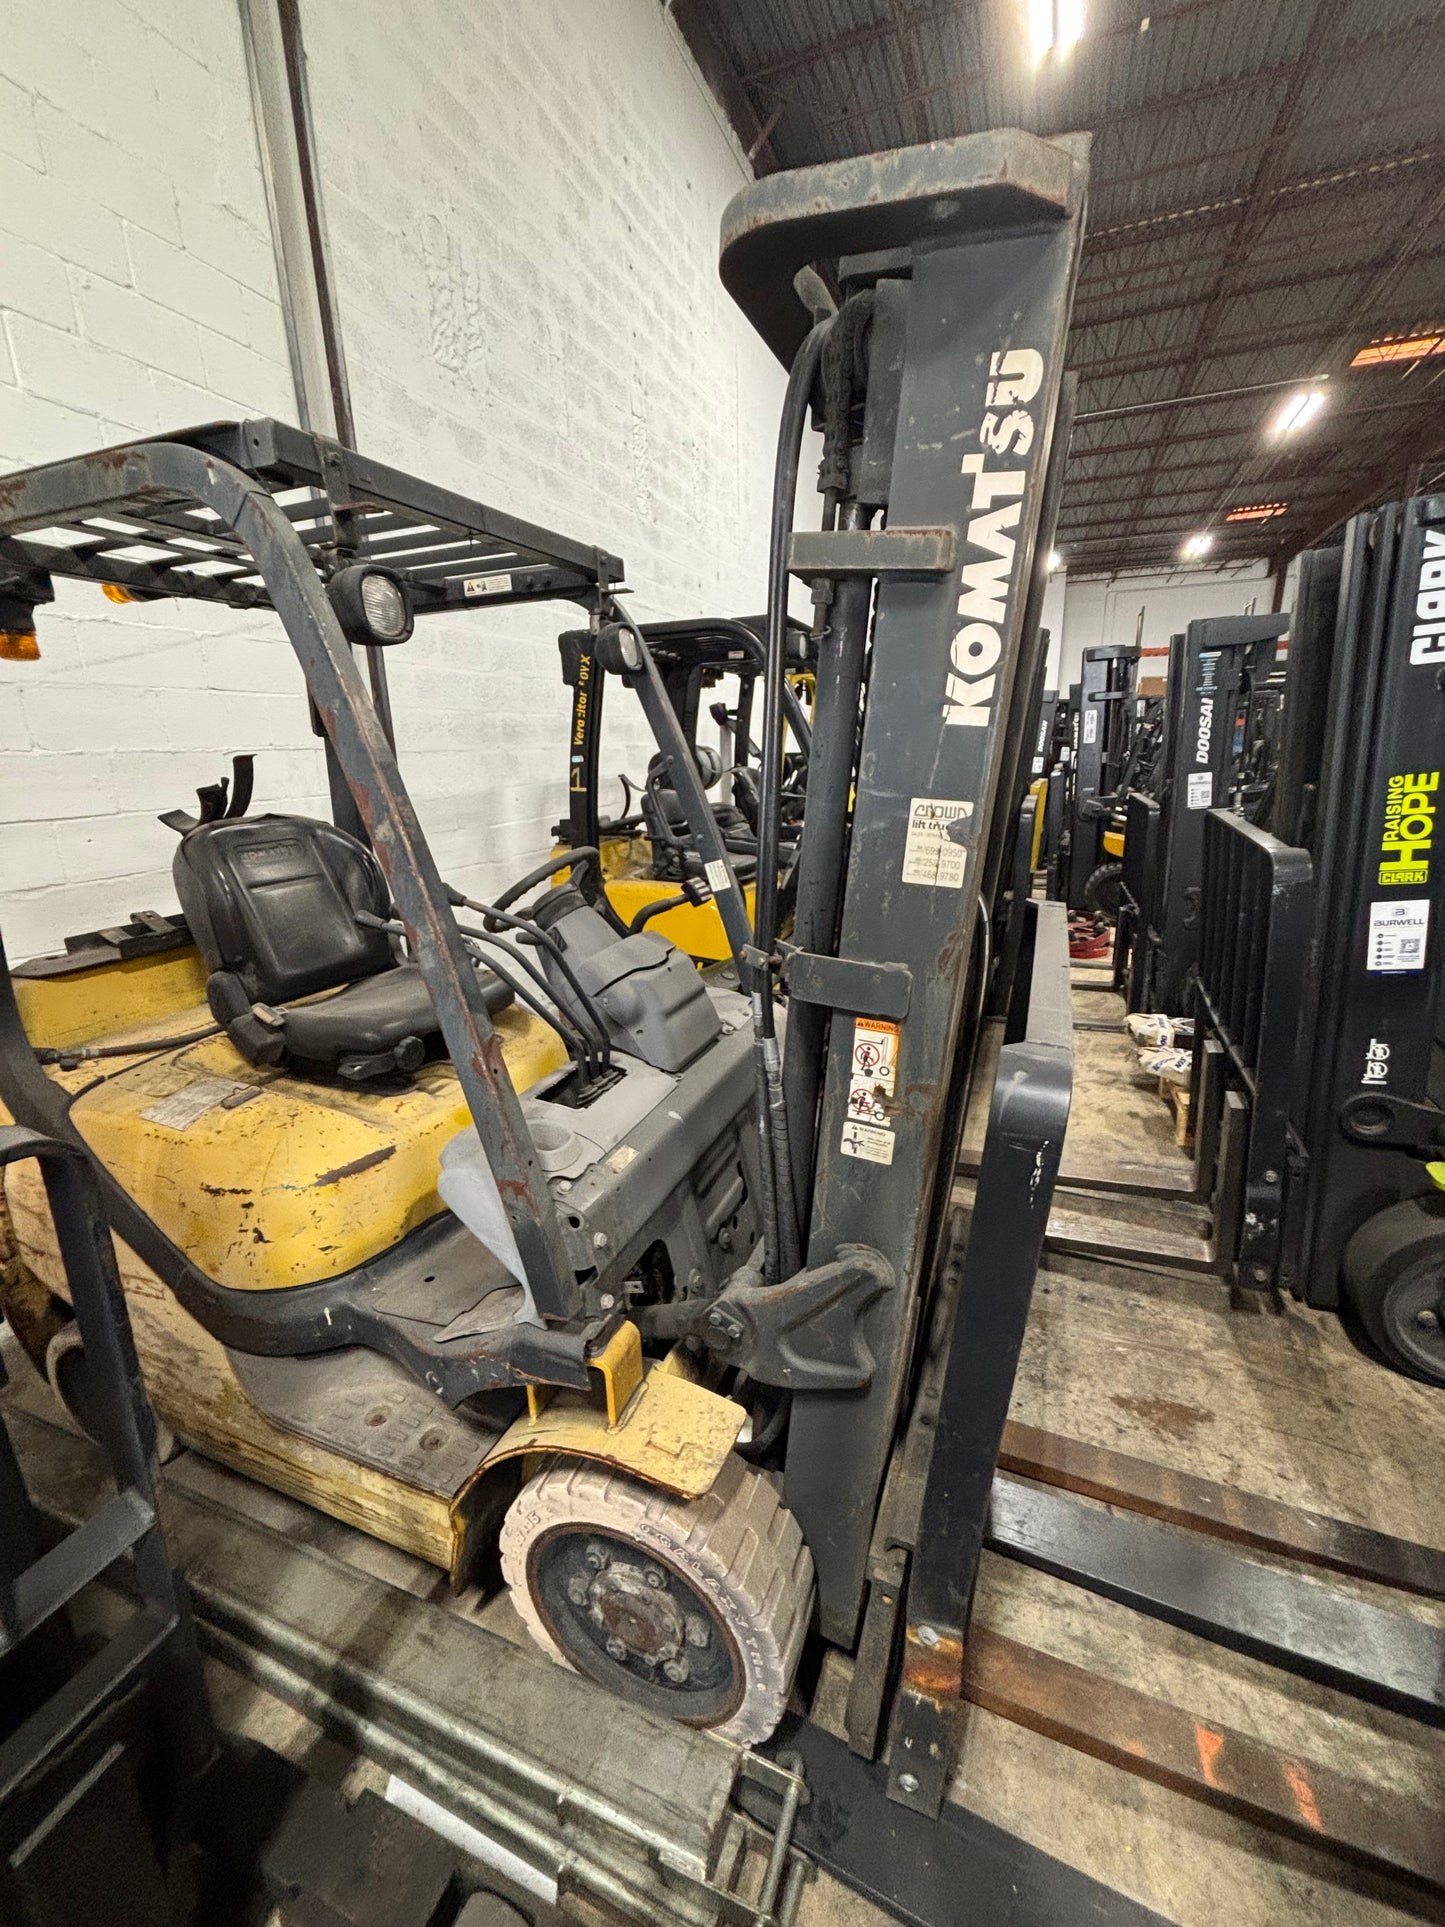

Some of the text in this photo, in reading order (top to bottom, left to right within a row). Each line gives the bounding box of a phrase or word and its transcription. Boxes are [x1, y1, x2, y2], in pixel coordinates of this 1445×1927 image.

[941, 347, 1044, 727] KOMATSU
[911, 819, 927, 830] lift
[1379, 771, 1440, 871] HOPE
[1382, 775, 1405, 842] RAISING
[1380, 872, 1425, 884] CLARK
[1373, 918, 1425, 927] BURWELL
